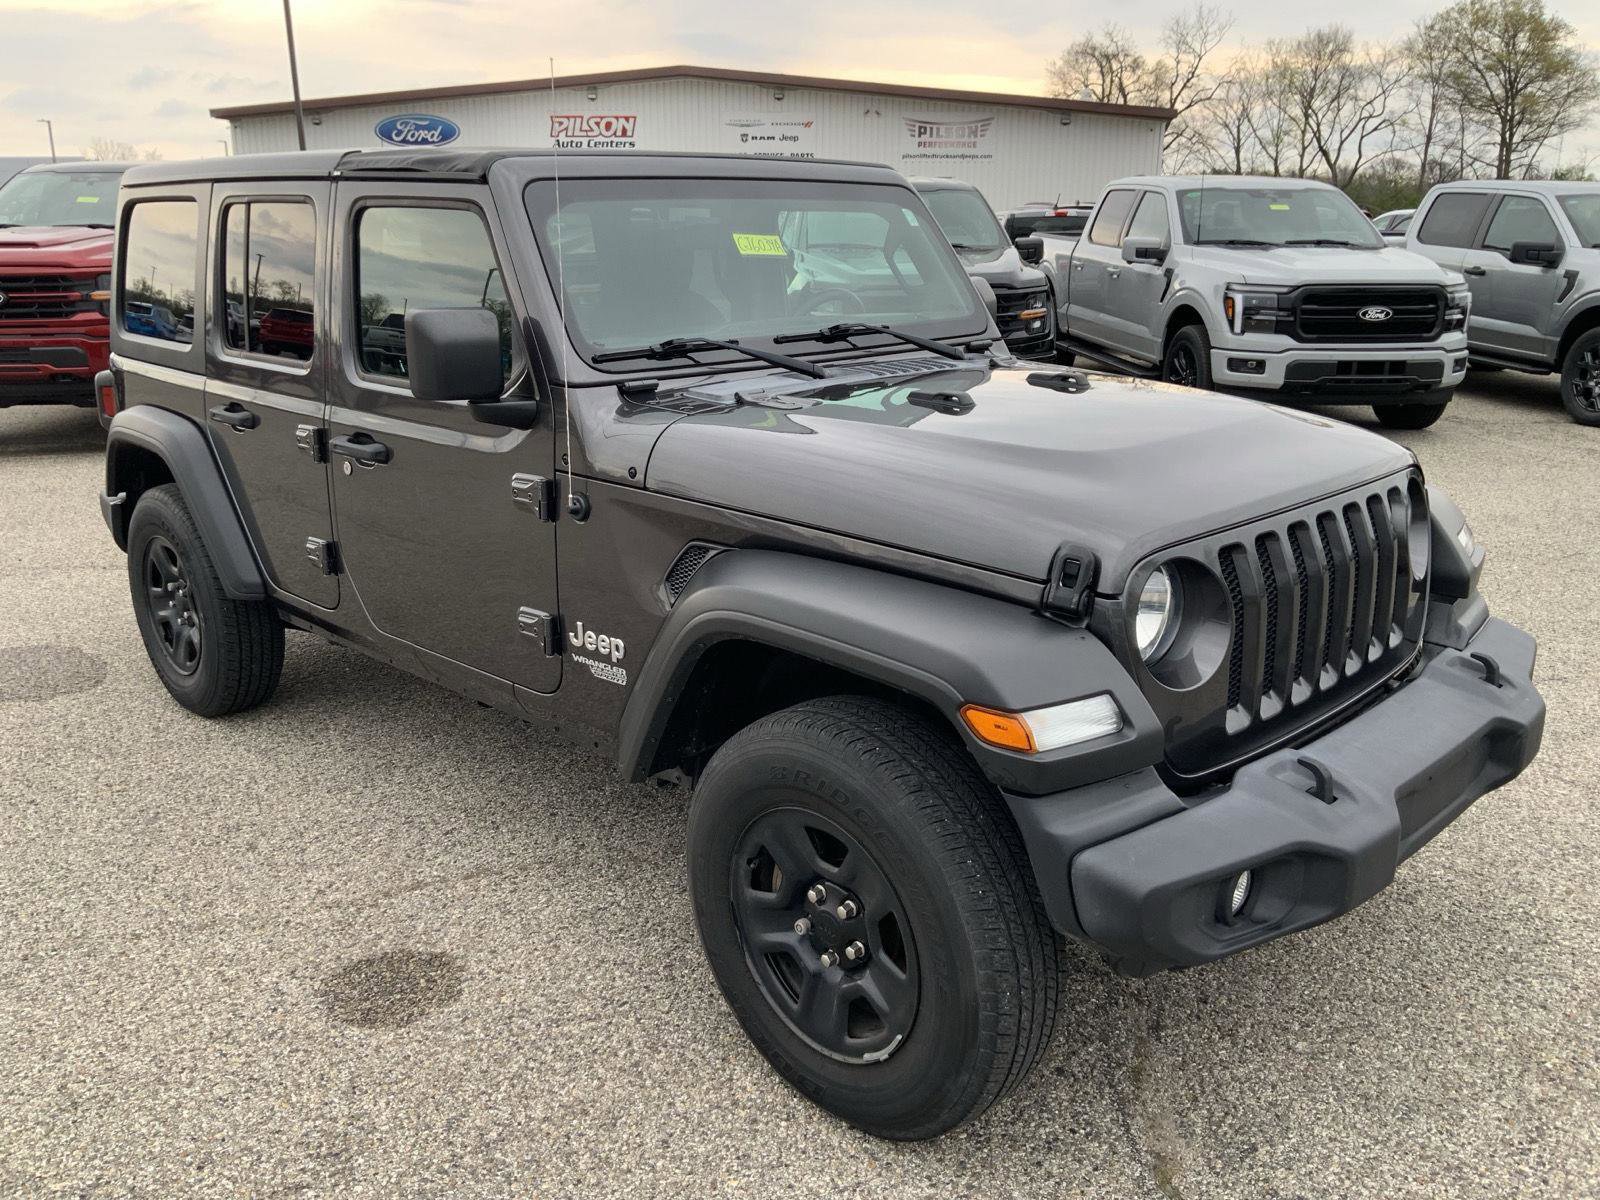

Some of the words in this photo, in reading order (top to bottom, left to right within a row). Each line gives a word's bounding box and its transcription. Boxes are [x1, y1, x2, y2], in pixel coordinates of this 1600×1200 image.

[392, 120, 443, 142] Ford
[550, 116, 637, 138] PILSON
[917, 125, 979, 138] PILSON
[553, 139, 583, 149] Auto
[587, 139, 636, 149] Centers
[779, 133, 799, 143] Jeep
[1365, 309, 1387, 319] Ford
[568, 621, 625, 663] Jeep
[571, 652, 627, 675] WRANGLER
